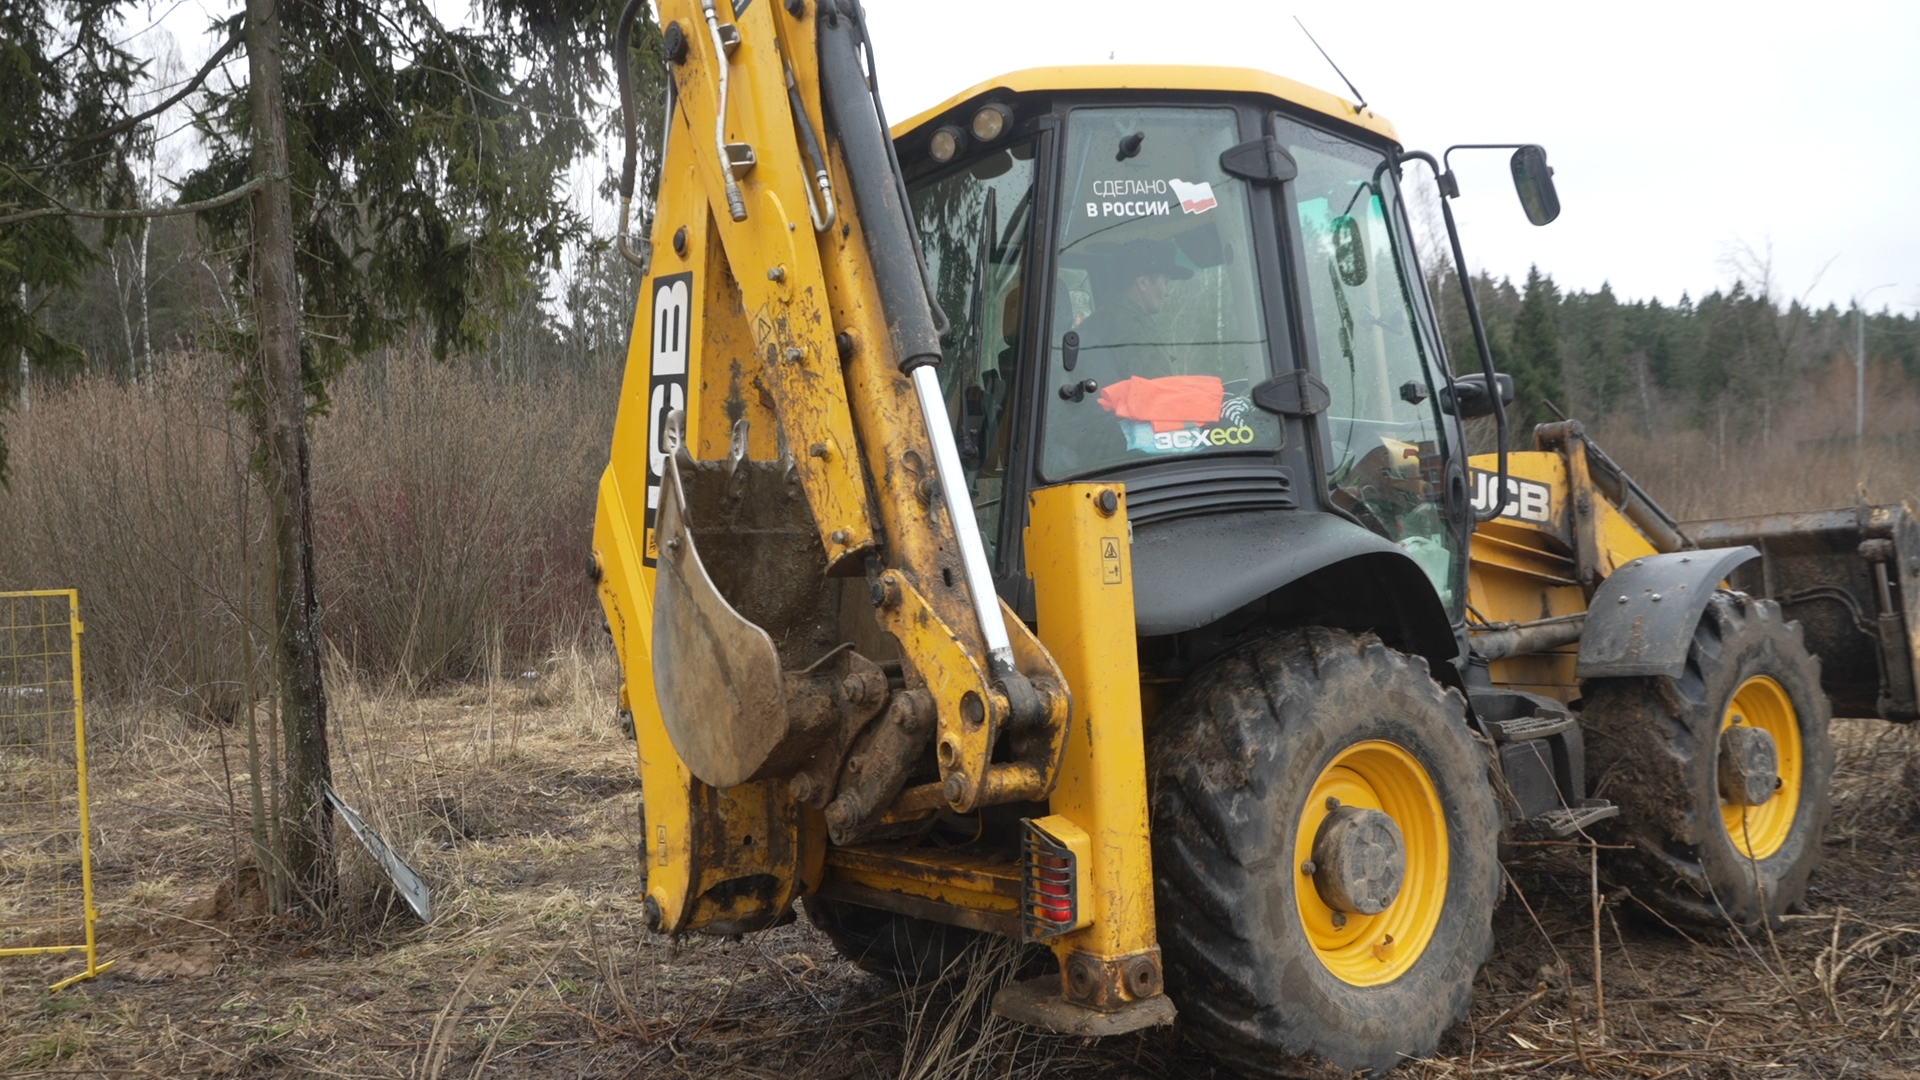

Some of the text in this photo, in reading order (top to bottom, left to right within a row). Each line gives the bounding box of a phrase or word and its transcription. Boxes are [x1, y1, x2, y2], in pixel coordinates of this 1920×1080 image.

[1093, 180, 1167, 198] СДЕЛАНО
[1086, 201, 1170, 217] В РОССИИ
[1470, 473, 1549, 522] JCB
